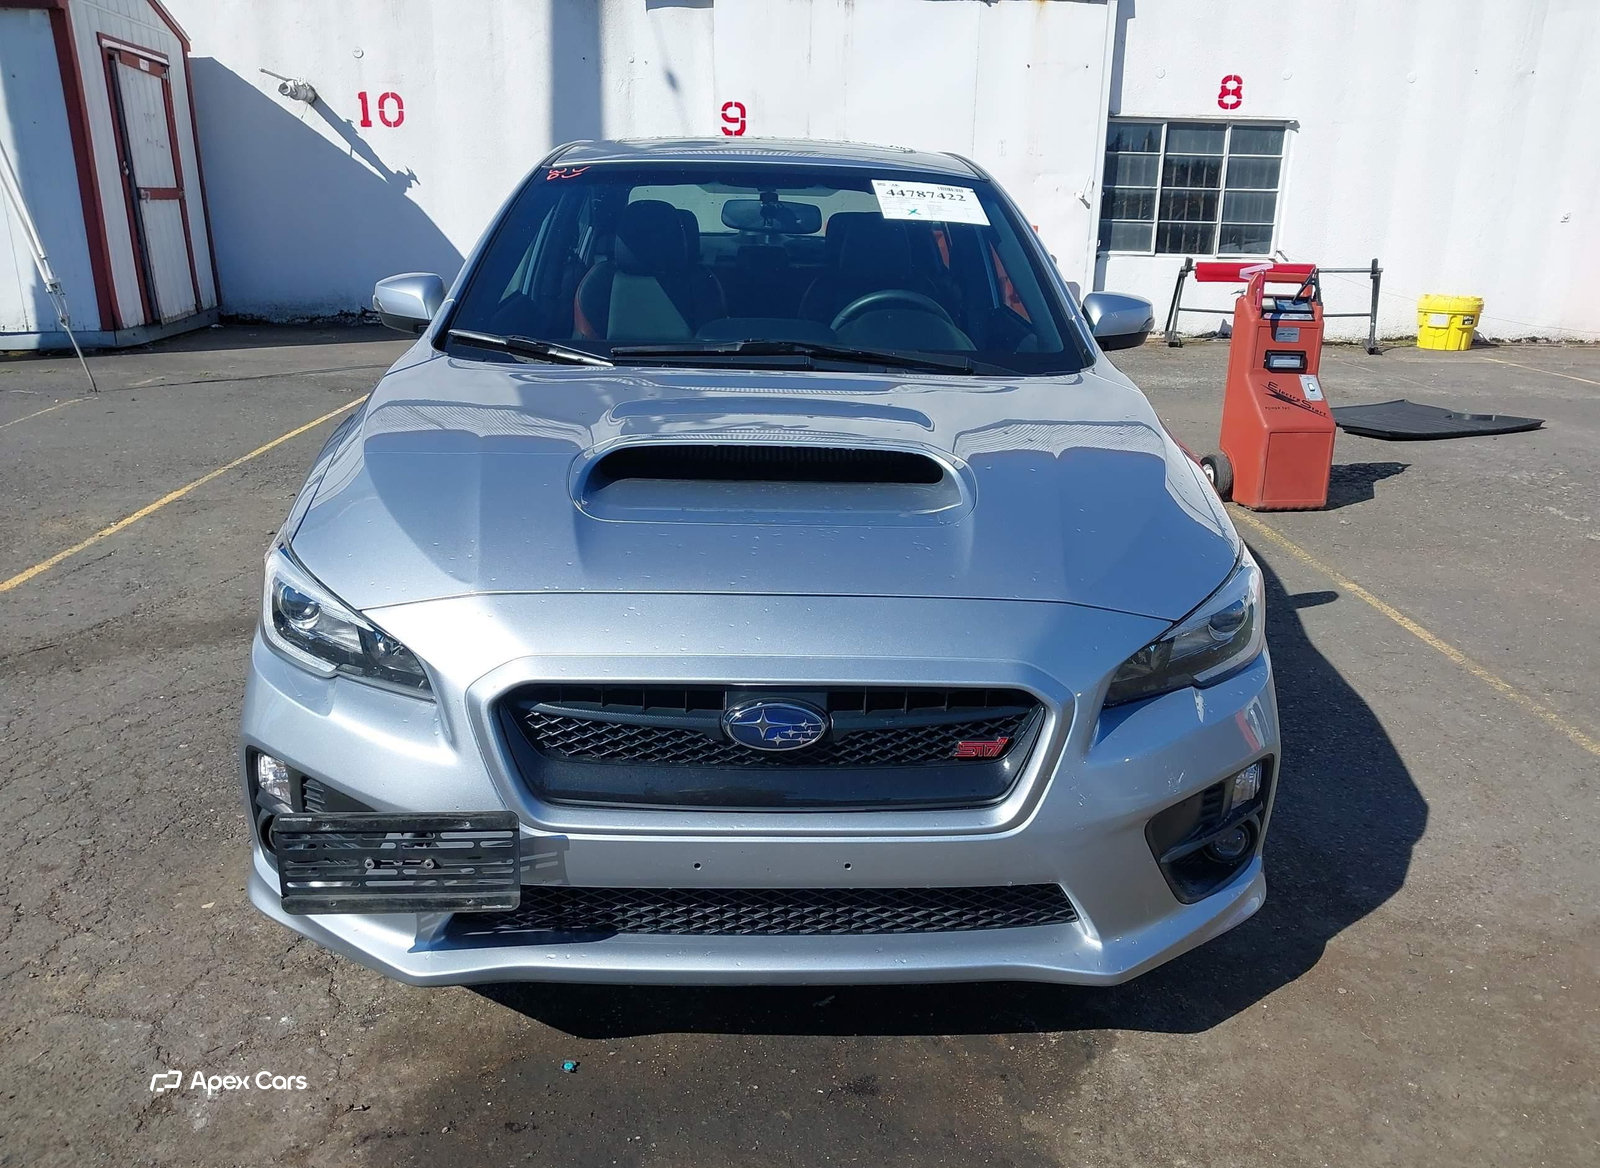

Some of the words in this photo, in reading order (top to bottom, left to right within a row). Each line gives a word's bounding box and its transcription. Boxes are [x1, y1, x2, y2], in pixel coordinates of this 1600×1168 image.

[358, 91, 404, 128] 10
[1217, 74, 1243, 110] 8
[721, 101, 746, 136] 9
[886, 189, 966, 202] 44787422
